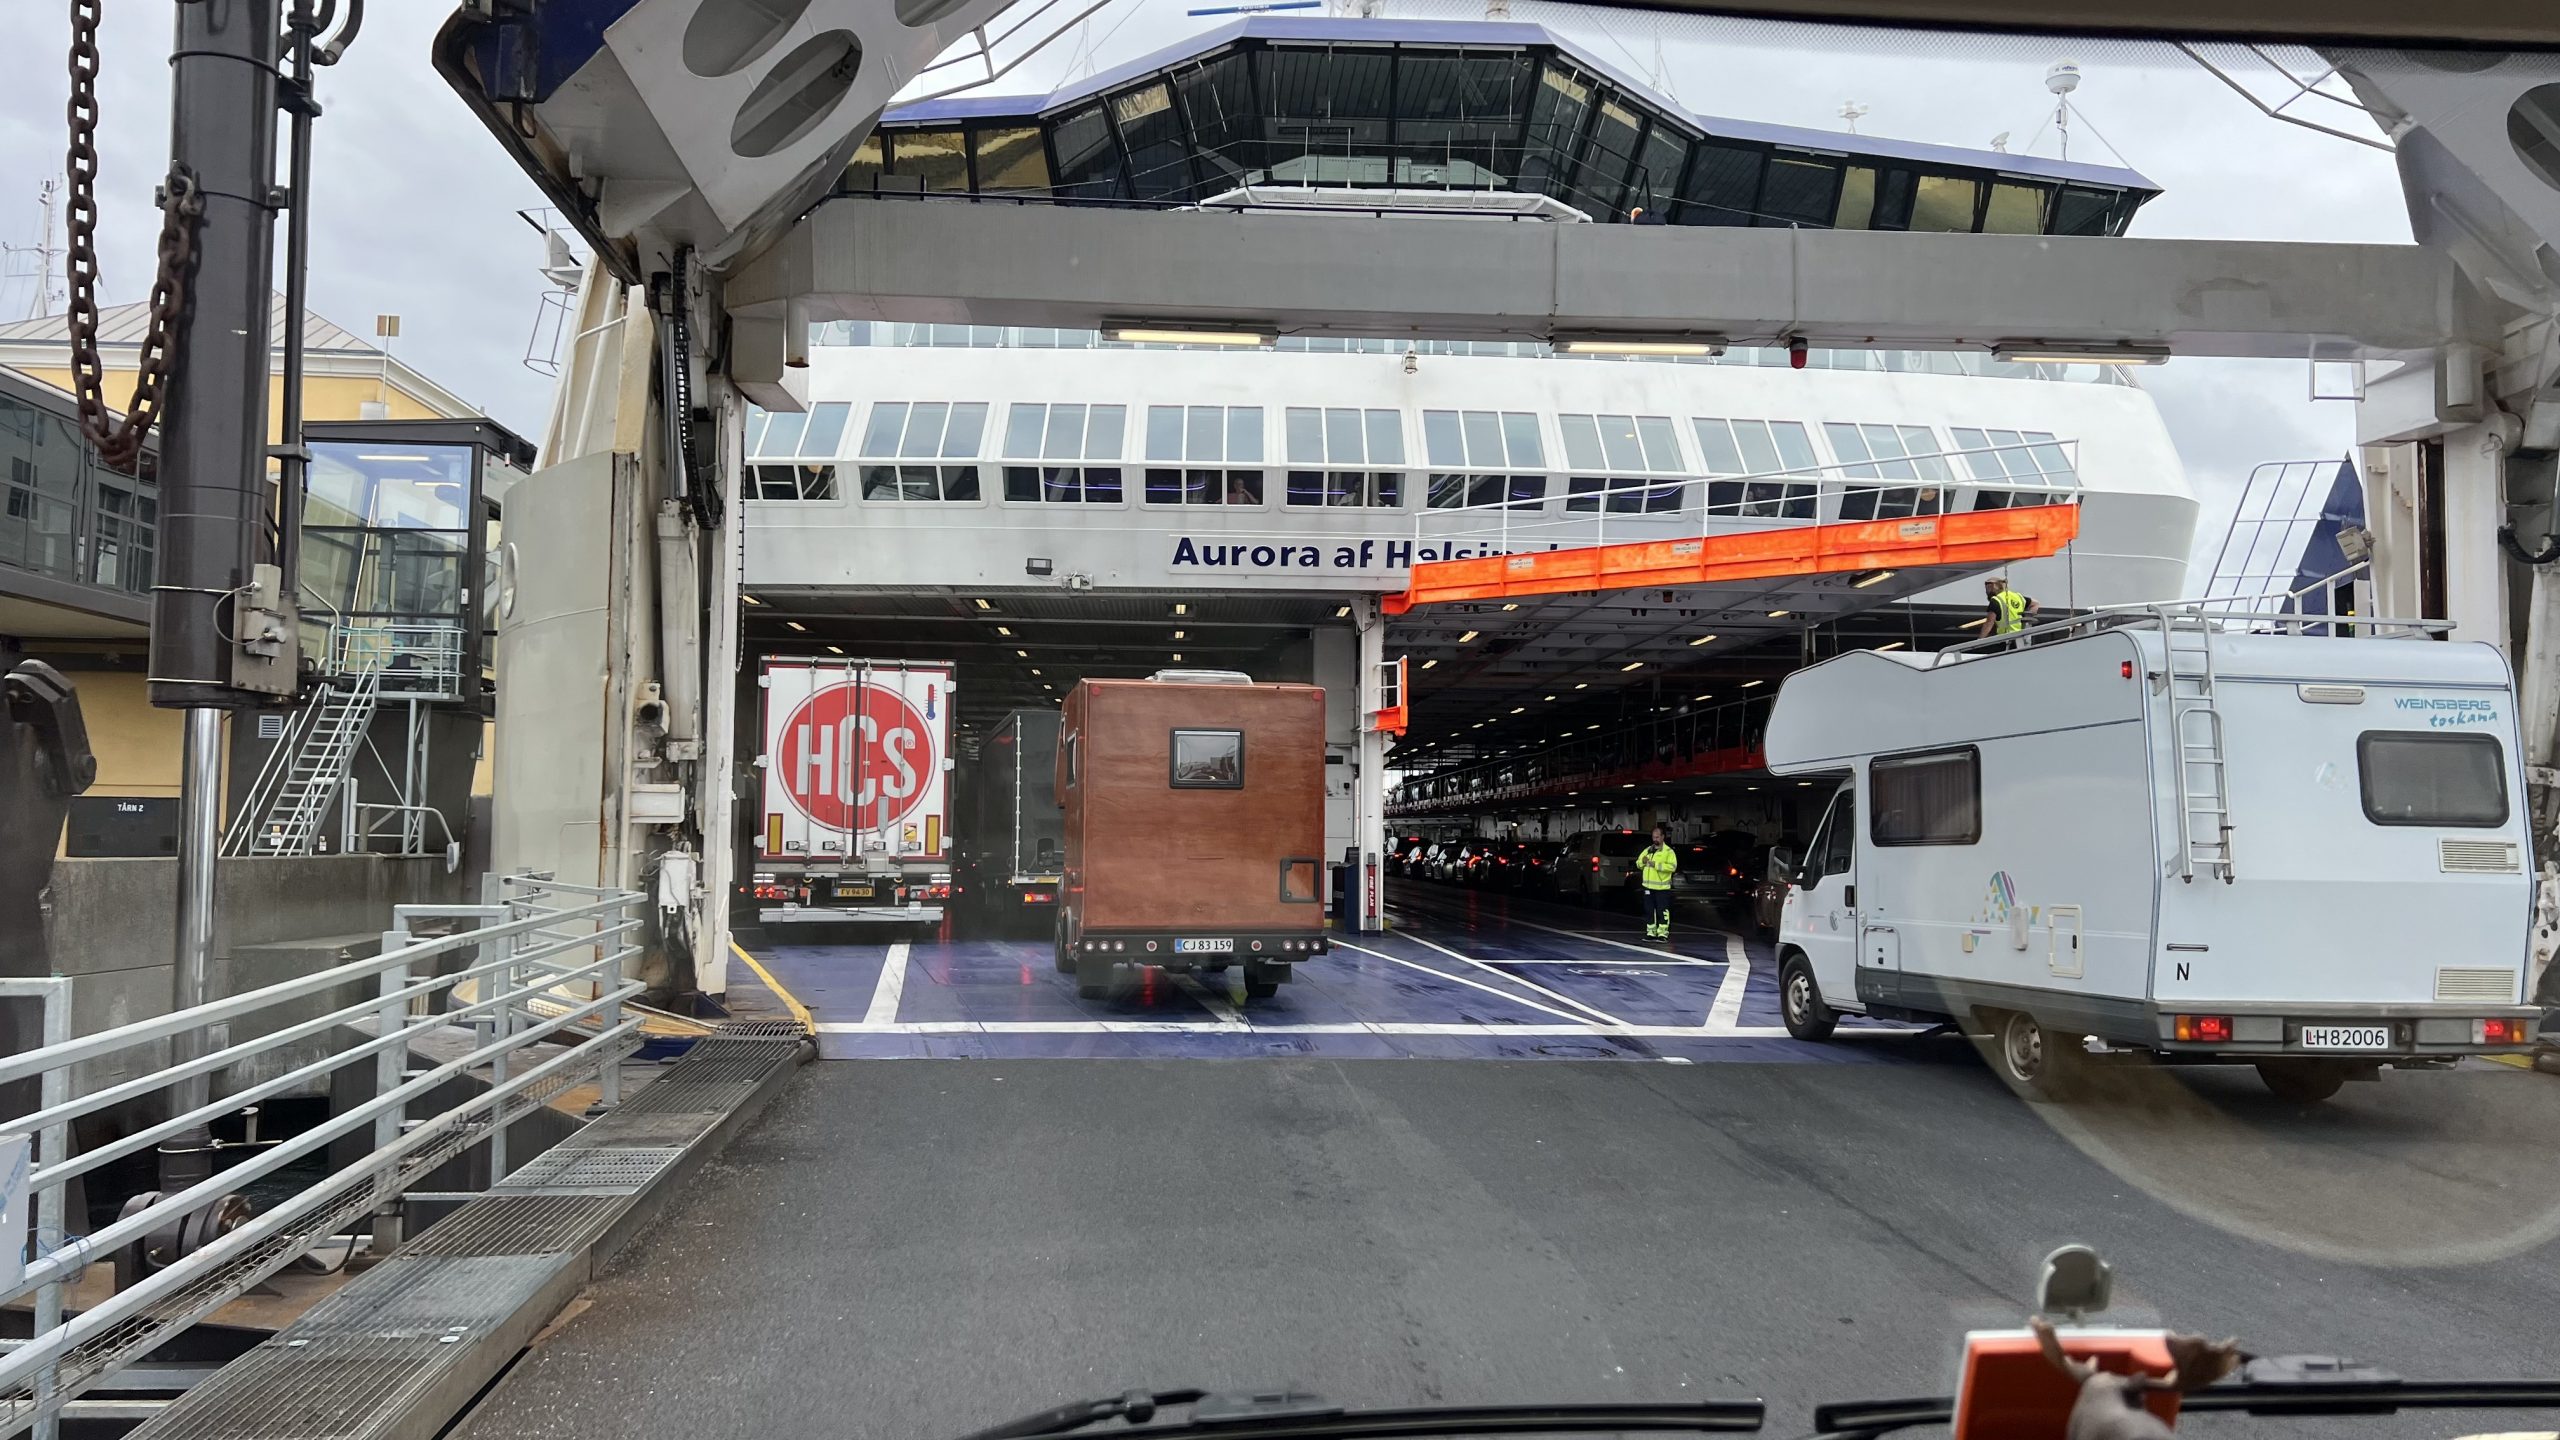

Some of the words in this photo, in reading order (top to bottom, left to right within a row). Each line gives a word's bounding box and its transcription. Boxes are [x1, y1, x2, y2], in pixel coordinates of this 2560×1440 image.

[1172, 537, 1320, 567] Aurora
[1333, 540, 1374, 568] af
[2394, 698, 2491, 711] WEINSBERG
[2430, 711, 2498, 728] toskana
[796, 714, 917, 807] HCS
[117, 802, 138, 812] TÅRN
[138, 804, 144, 812] 2
[1182, 940, 1196, 951] CJ
[1198, 940, 1211, 951] 83
[1214, 940, 1232, 950] 159
[2176, 962, 2190, 981] N
